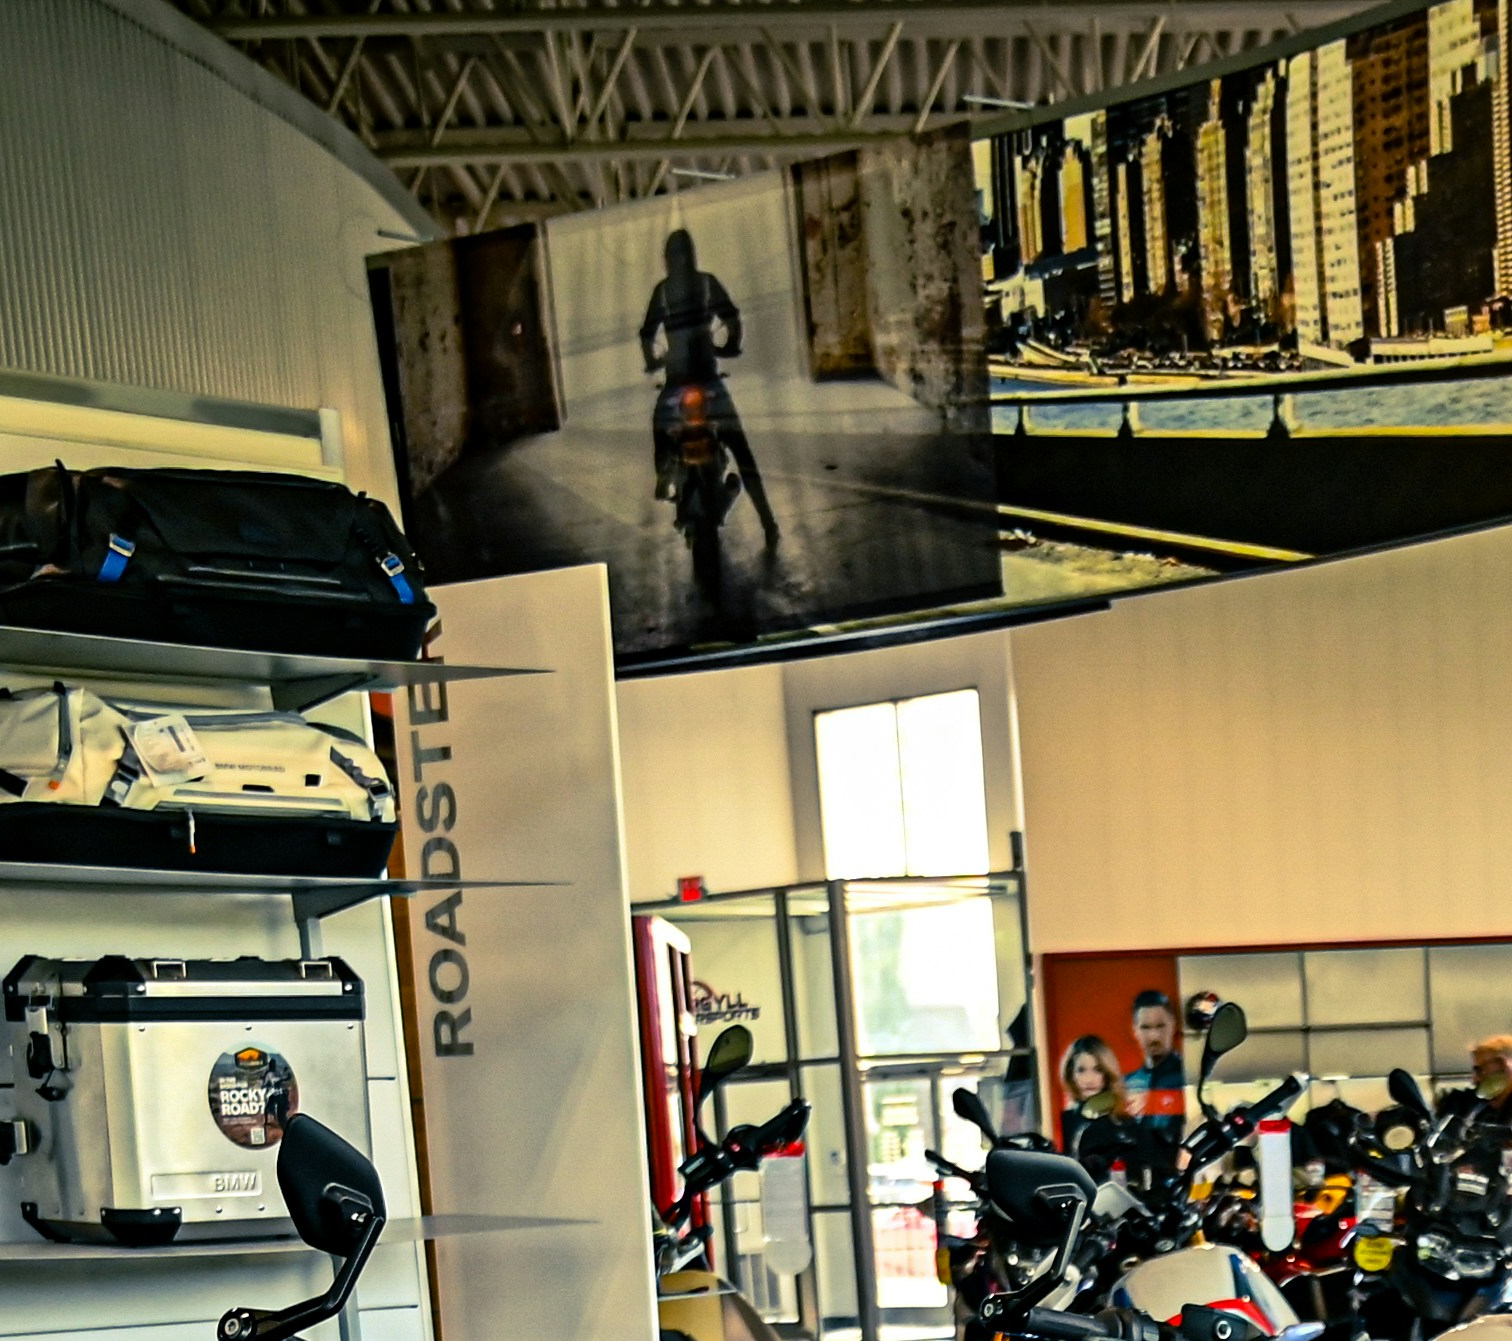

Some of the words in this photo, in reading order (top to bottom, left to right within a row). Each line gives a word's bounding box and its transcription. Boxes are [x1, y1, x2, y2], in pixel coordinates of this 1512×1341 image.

[220, 1088, 266, 1103] ROCKY
[221, 1102, 265, 1116] ROAD?
[213, 1171, 258, 1194] BMW
